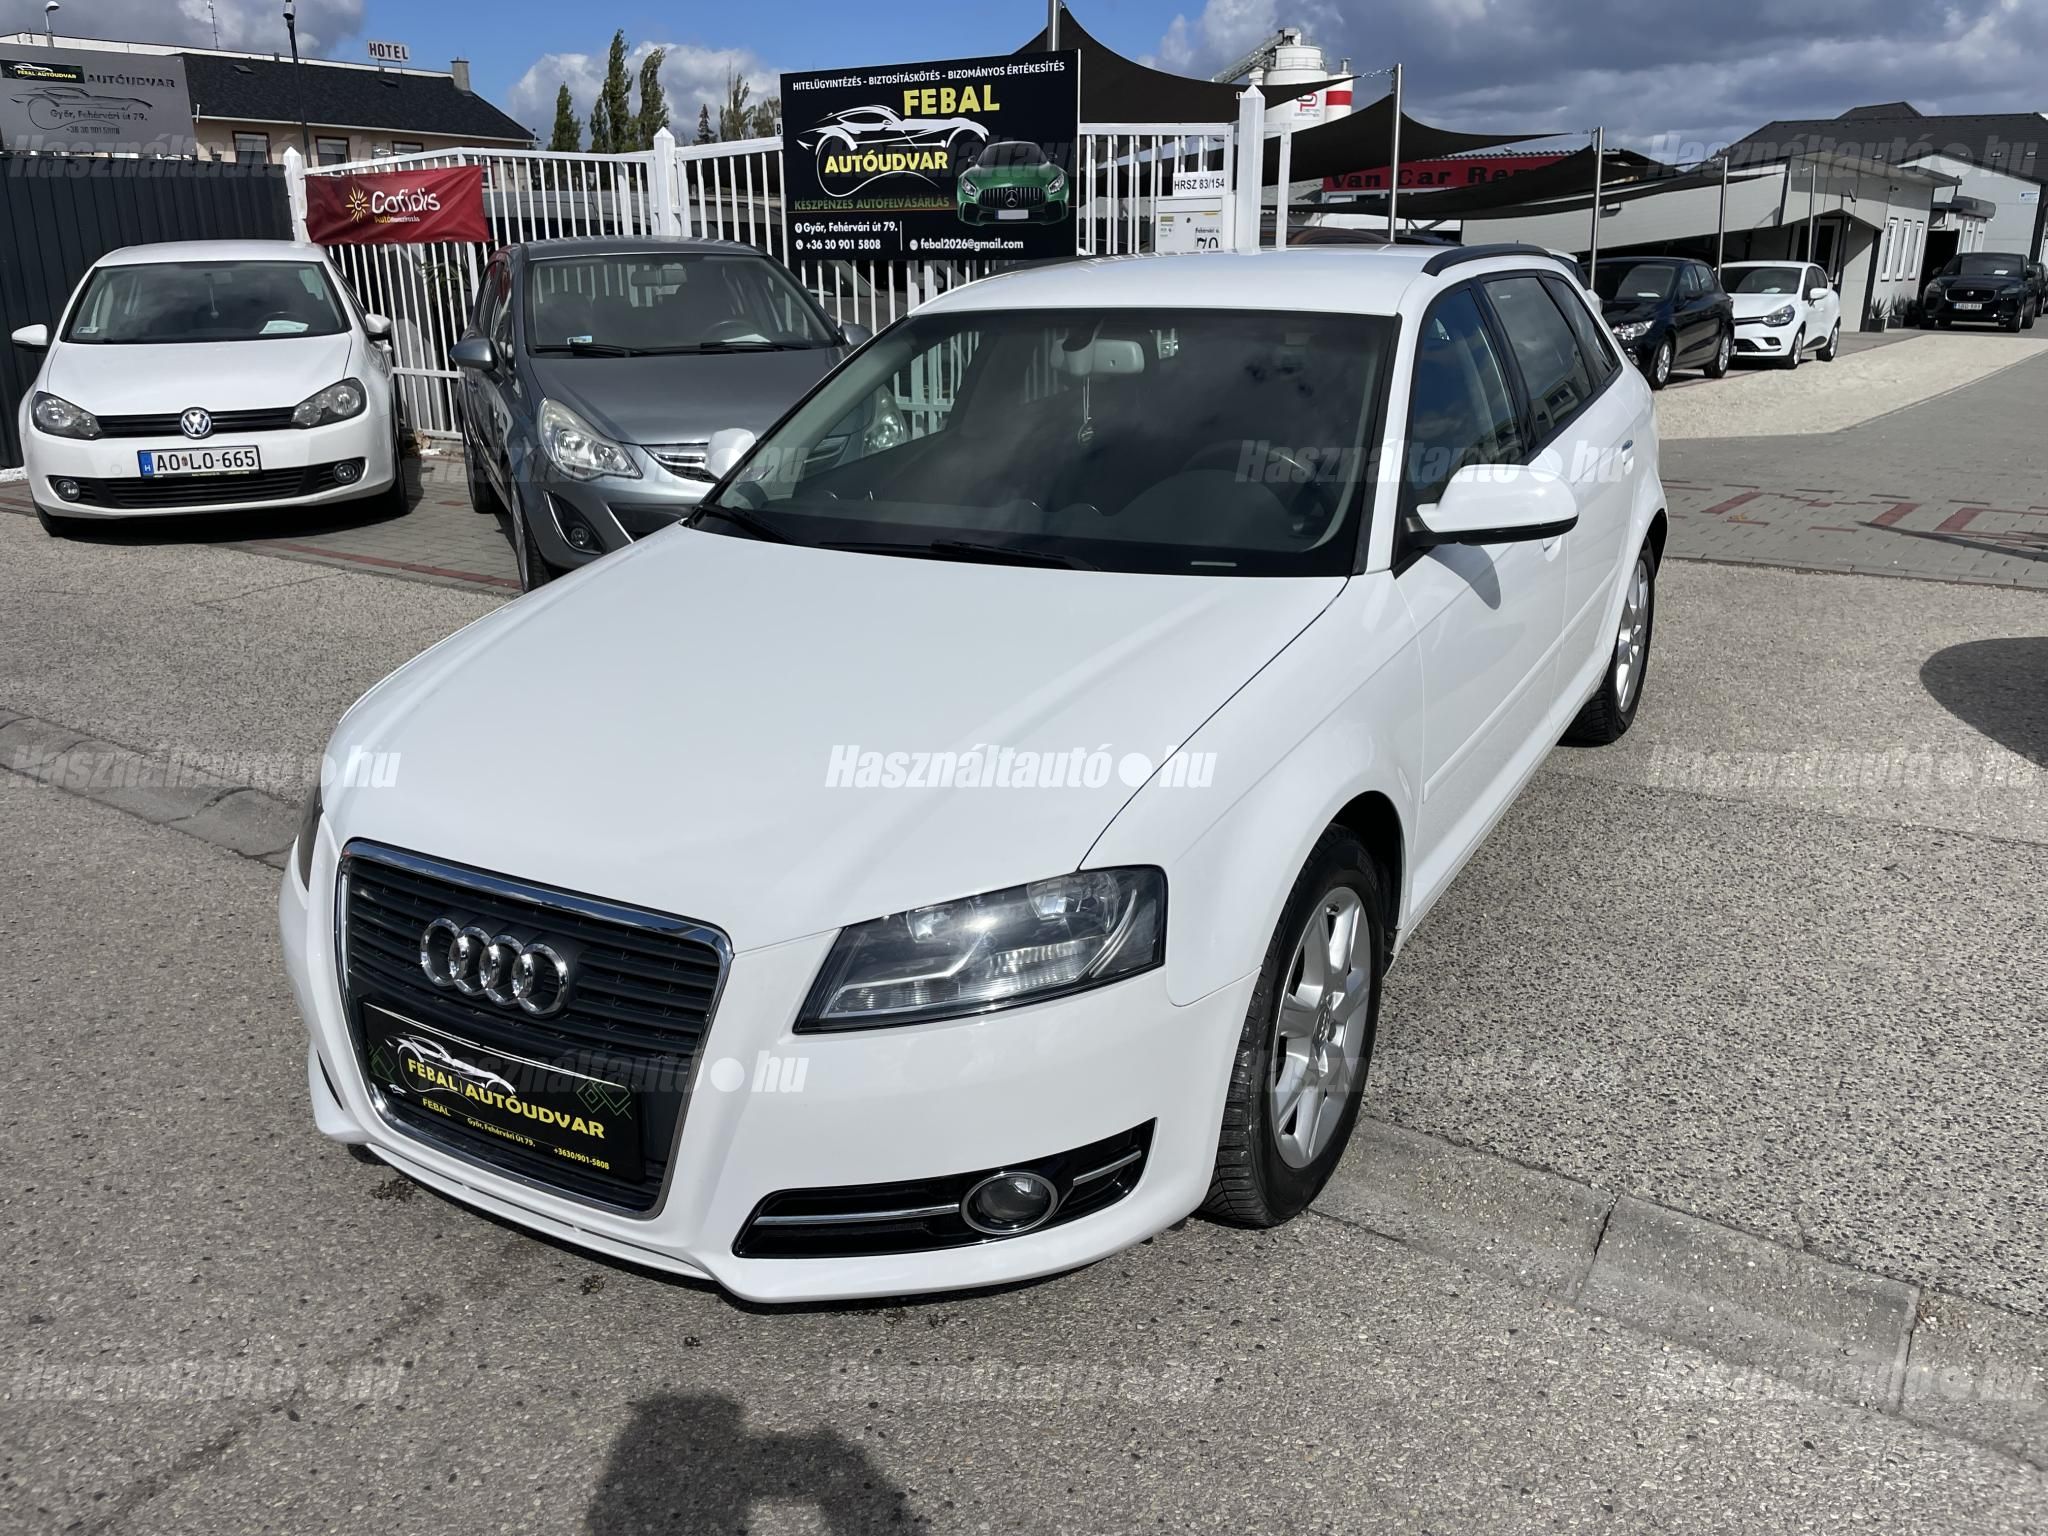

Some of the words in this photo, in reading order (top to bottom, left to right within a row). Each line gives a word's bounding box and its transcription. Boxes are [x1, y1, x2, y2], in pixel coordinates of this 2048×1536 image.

[369, 42, 408, 60] HOTEL
[86, 74, 175, 88] AUTÓUDVAR
[792, 76, 862, 91] HITELÜGYINTÉZÉS
[868, 71, 941, 86] BIZTOSÍTÁSKÖTÉS
[947, 66, 1005, 80] BIZOMÁNYOS
[1007, 60, 1065, 75] ÉRTÉKESÍTÉS
[903, 84, 1000, 116] FEBAL
[824, 150, 948, 174] AUTÓUDVAR
[1174, 180, 1197, 190] HRSZ
[1199, 179, 1224, 189] 83/154
[1331, 175, 1381, 189] Van
[1400, 170, 1451, 187] Car
[371, 188, 440, 214] Cofidis
[794, 200, 853, 211] KÉSZPÉNZES
[856, 196, 950, 209] AUTÓFELVÁSÁRLÁS
[804, 221, 827, 235] Győr,
[828, 221, 870, 232] Fehérvári
[872, 221, 881, 231] út
[883, 221, 898, 232] 79.
[806, 239, 823, 249] +36
[825, 239, 837, 249] 30
[838, 239, 855, 249] 901
[858, 239, 881, 249] 5808
[920, 238, 1024, 252] febal2026@gmail.com
[408, 1058, 458, 1092] FEBAL
[465, 1084, 605, 1139] AUTÓUDVAR
[422, 1098, 451, 1117] FEBAL
[467, 1117, 484, 1130] Győr,
[554, 1147, 610, 1171] +3630/901-5808
